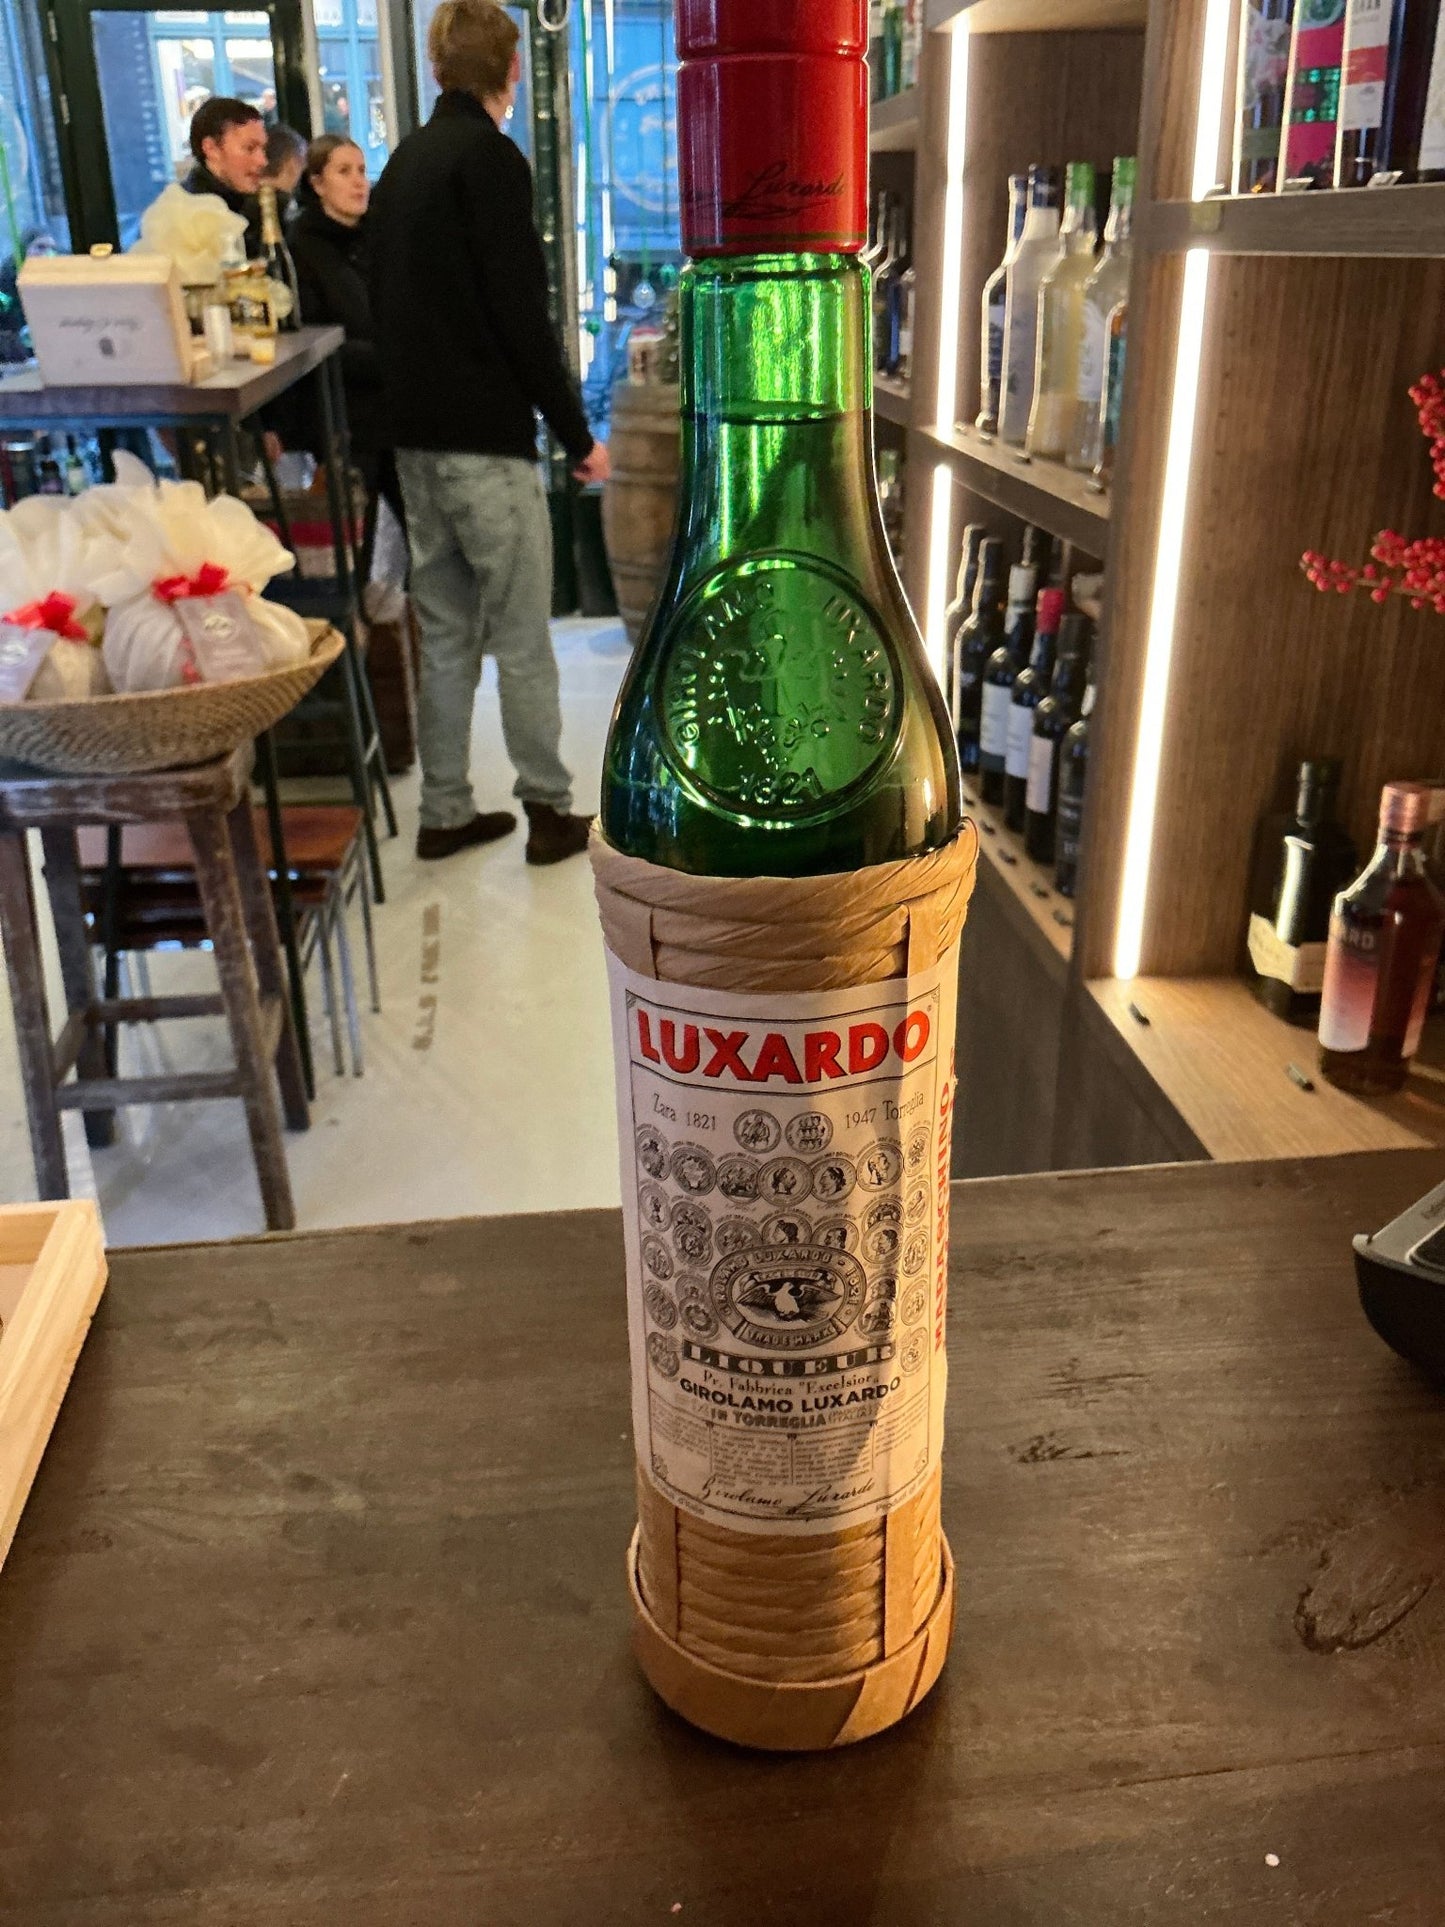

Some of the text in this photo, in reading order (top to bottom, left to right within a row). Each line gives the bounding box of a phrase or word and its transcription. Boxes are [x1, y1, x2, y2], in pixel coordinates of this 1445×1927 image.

[637, 1008, 931, 1084] LUXARDO
[653, 1092, 717, 1131] Zara 1821
[845, 1091, 925, 1129] 1947 Torreglia
[754, 1249, 833, 1264] LUXARDO
[685, 1341, 897, 1377] LIQUEUR
[680, 1376, 901, 1413] GIROLAMO LUXARDO
[729, 1376, 793, 1396] Fabbrica
[733, 1411, 828, 1429] TORREGLIA
